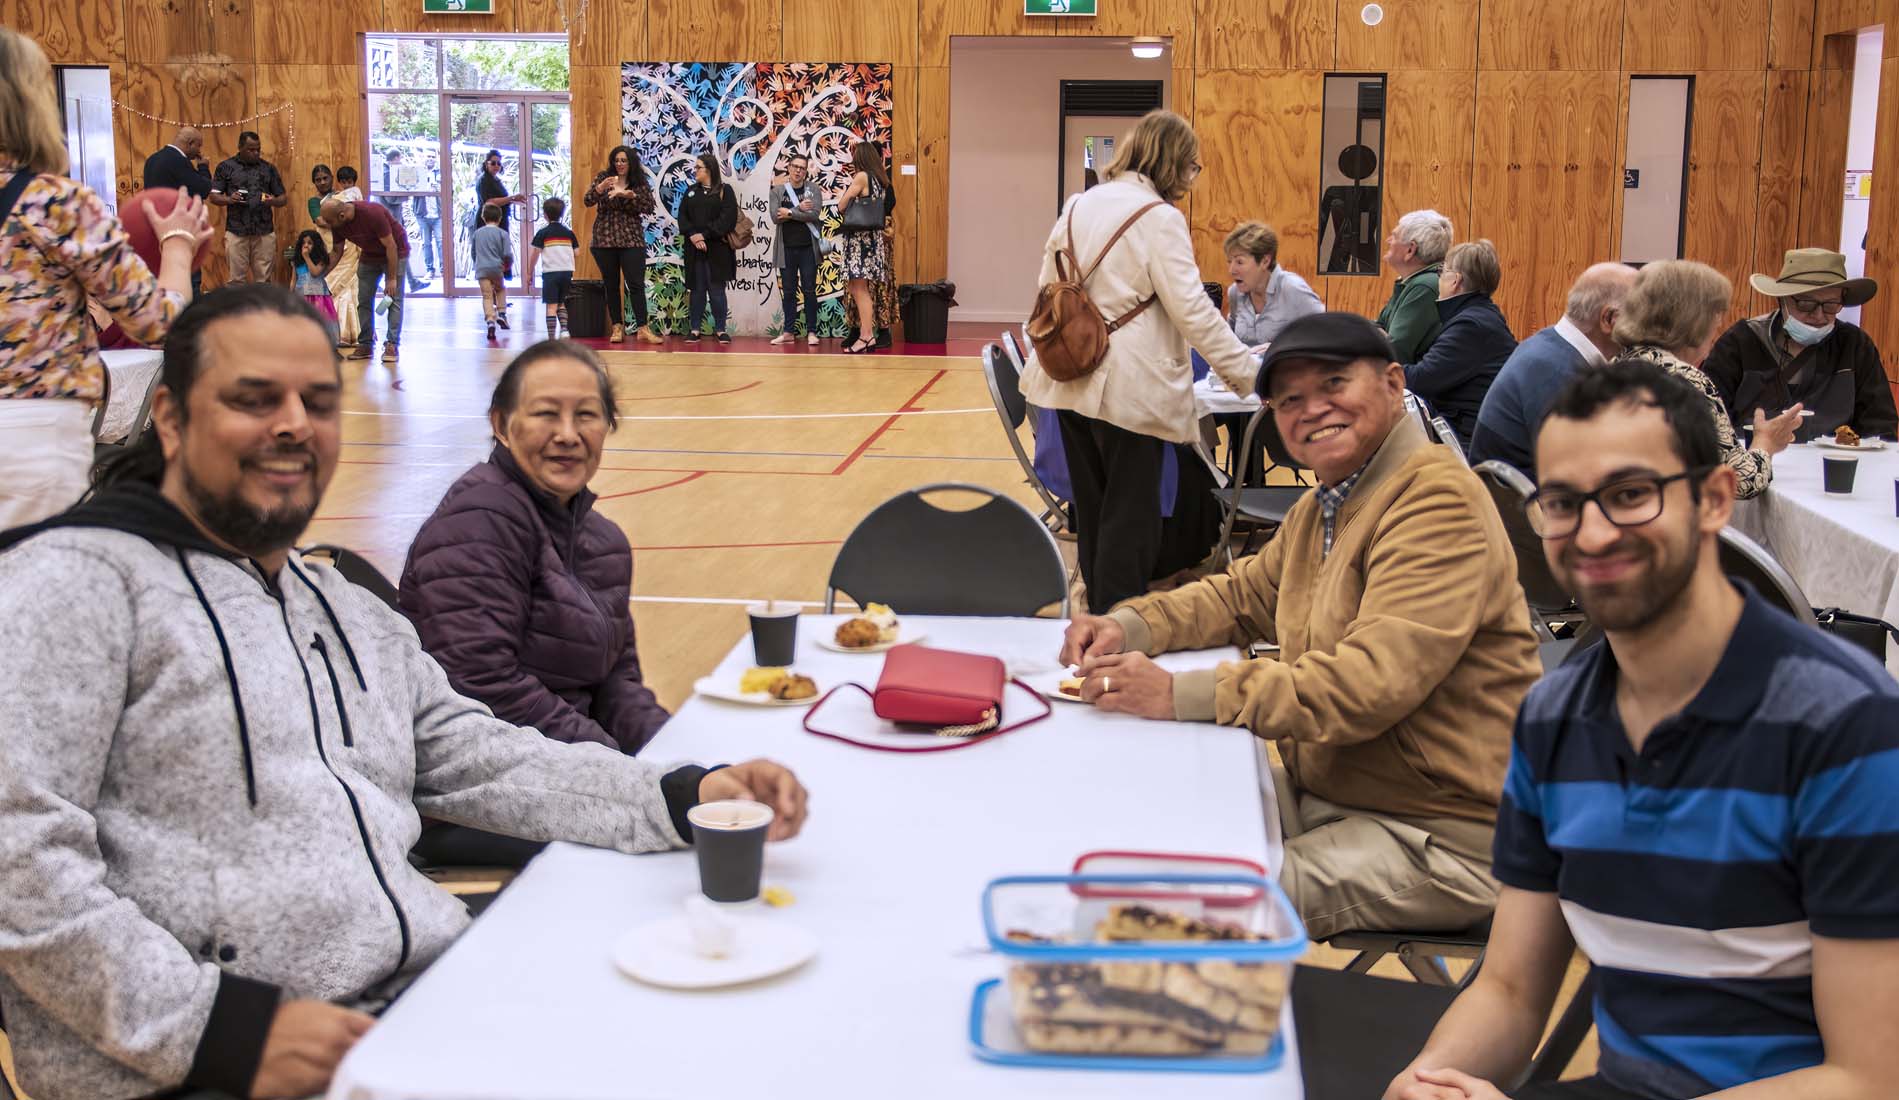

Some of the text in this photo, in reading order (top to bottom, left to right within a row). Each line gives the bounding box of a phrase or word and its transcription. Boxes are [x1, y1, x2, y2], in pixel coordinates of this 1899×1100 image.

[739, 193, 768, 212] Lukes
[752, 235, 772, 255] ony
[736, 251, 773, 279] ebrating
[727, 279, 774, 305] iversity
